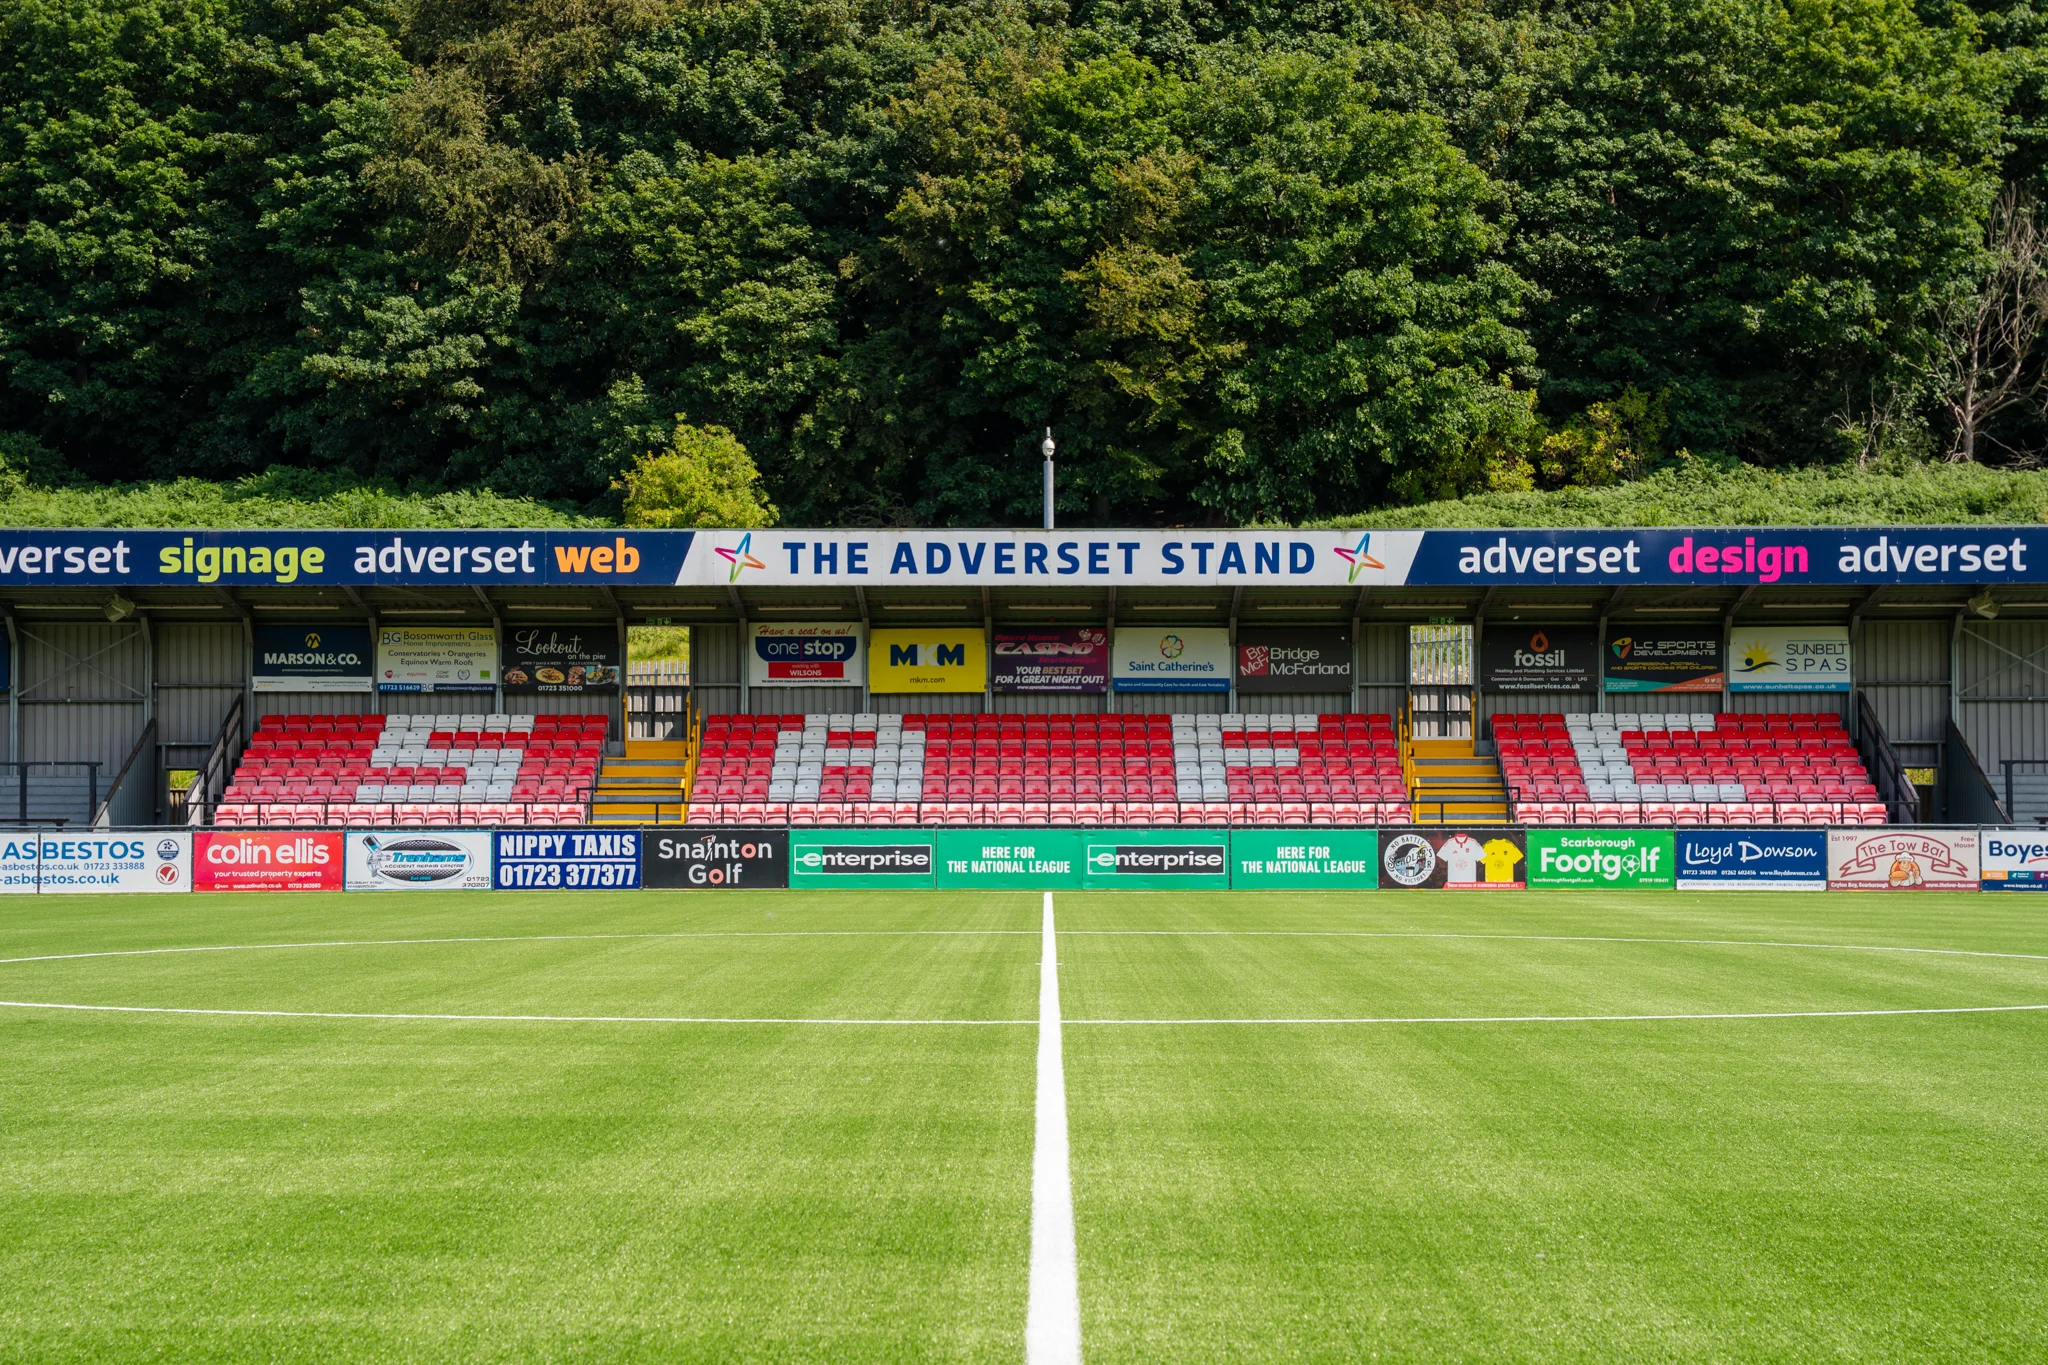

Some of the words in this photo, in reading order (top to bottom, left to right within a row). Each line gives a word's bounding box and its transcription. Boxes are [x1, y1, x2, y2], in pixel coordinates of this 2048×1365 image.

[0, 540, 129, 573] verset
[159, 538, 325, 582] signage
[354, 538, 535, 573] adverset
[554, 538, 640, 573] web
[782, 542, 868, 574] THE
[890, 542, 1140, 574] ADVERSET
[1161, 542, 1314, 574] STAND
[1459, 538, 1640, 573] adverset
[1668, 537, 1808, 582] design
[1838, 536, 2026, 572] adverset
[382, 632, 401, 645] BG
[404, 631, 464, 640] Bosomworth
[468, 632, 493, 640] Glass
[758, 625, 784, 635] Have
[835, 625, 852, 635] us!
[516, 630, 581, 655] Lookout
[768, 643, 799, 655] one
[804, 640, 845, 659] stop
[995, 643, 1093, 654] CASINO
[1786, 643, 1847, 655] SUNBELT
[593, 653, 606, 661] pier
[890, 644, 964, 666] MKM
[1270, 648, 1319, 662] Bridge
[1514, 650, 1565, 667] fossil
[1129, 661, 1155, 671] Saint
[1158, 661, 1214, 671] Catherine's
[1271, 662, 1350, 675] McFarland
[1786, 658, 1847, 671] SPAS
[2, 841, 144, 860] ASBESTOS
[207, 838, 271, 864] colin
[276, 838, 329, 864] ellis
[500, 835, 564, 856] NIPPY
[572, 834, 636, 856] TAXIS
[1561, 837, 1635, 850] Scarborough
[1861, 844, 1886, 857] The
[1889, 840, 1917, 851] Tow
[1922, 842, 1945, 857] Bar
[392, 852, 466, 863] Trenhams
[803, 850, 929, 870] enterprise
[982, 846, 1010, 859] HERE
[1013, 846, 1035, 859] FOR
[1097, 850, 1223, 870] enterprise
[1277, 846, 1305, 859] HERE
[1308, 846, 1330, 859] FOR
[1686, 843, 1733, 865] Lloyd
[1738, 841, 1817, 863] Dowson
[947, 860, 968, 873] THE
[971, 860, 1025, 873] NATIONAL
[1028, 860, 1071, 873] LEAGUE
[1242, 860, 1263, 873] THE
[1266, 860, 1320, 873] NATIONAL
[1324, 860, 1365, 873] LEAGUE
[1541, 847, 1660, 880] Footgolf
[500, 864, 561, 886] 01723
[566, 864, 636, 886] 377377
[688, 863, 742, 884] Golf
